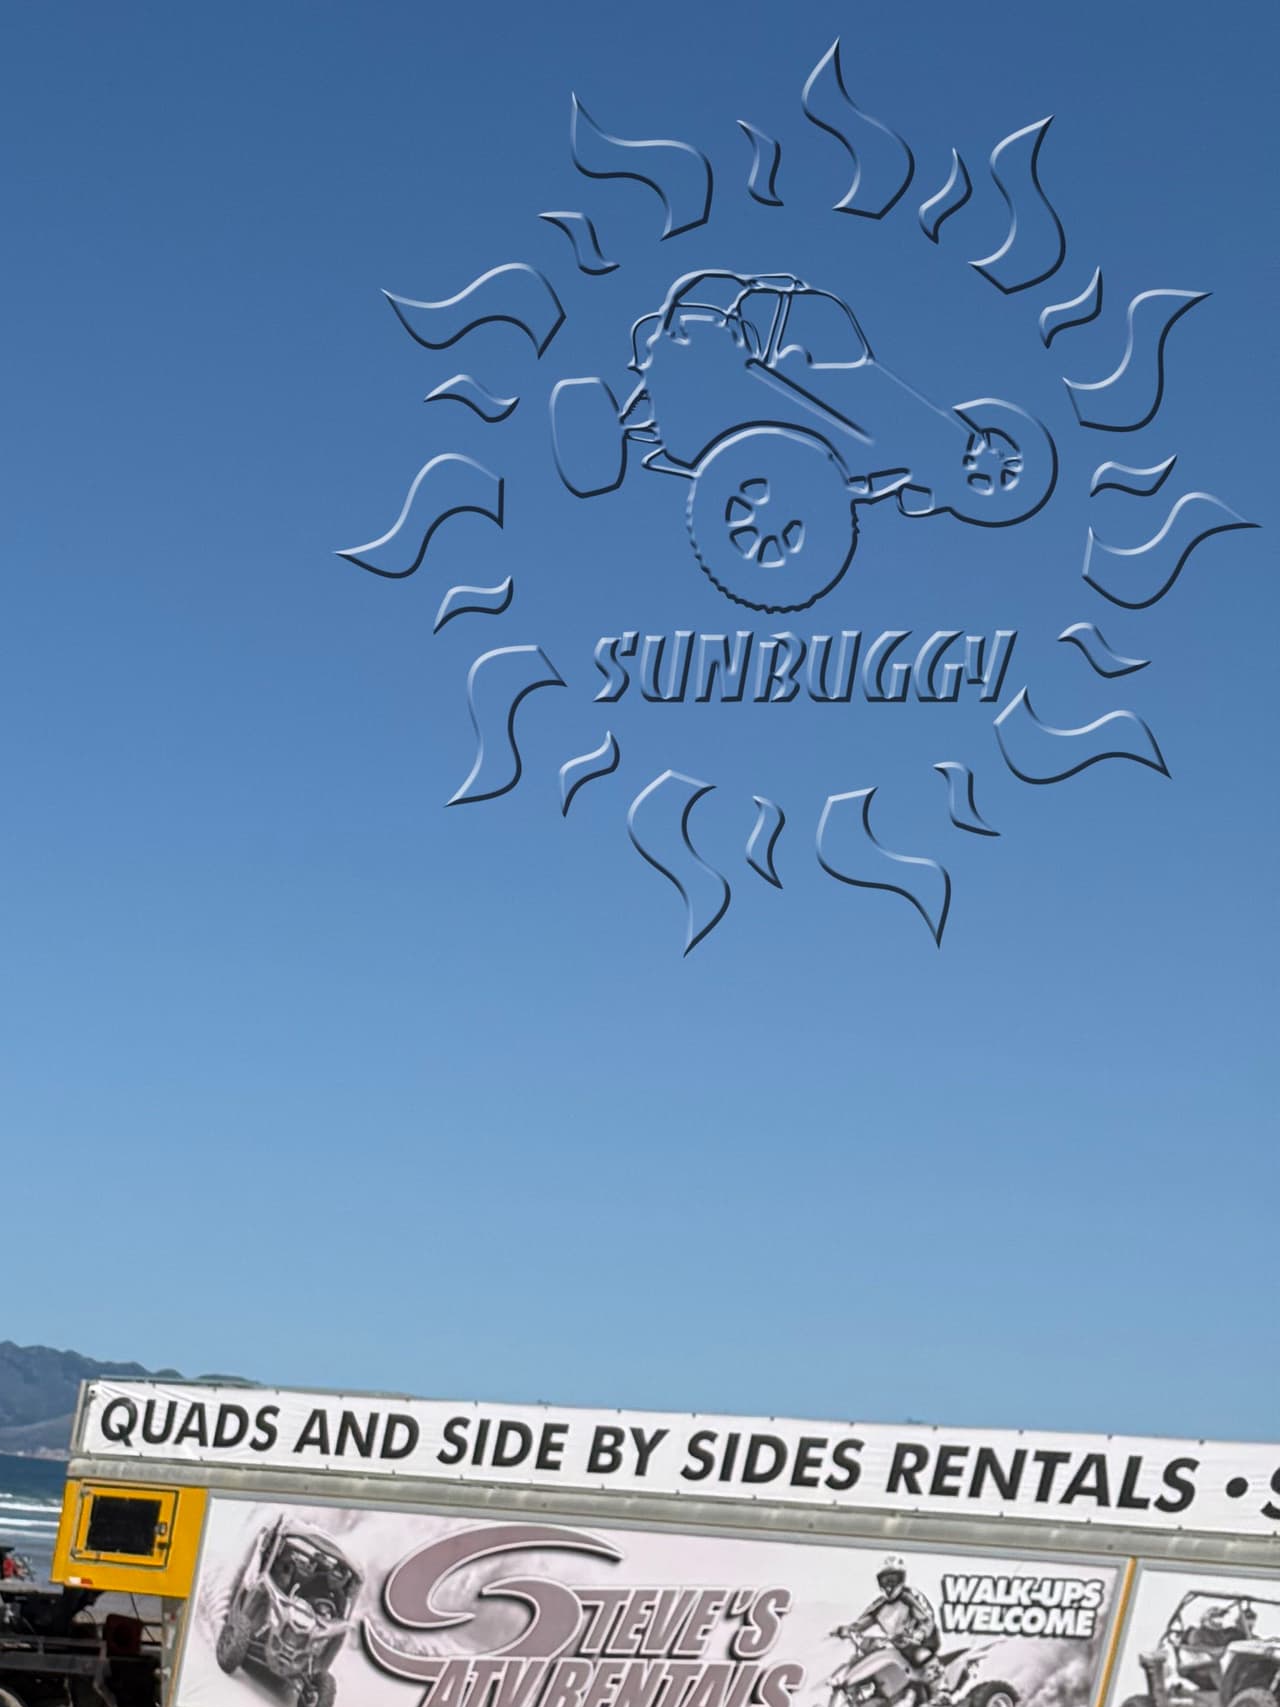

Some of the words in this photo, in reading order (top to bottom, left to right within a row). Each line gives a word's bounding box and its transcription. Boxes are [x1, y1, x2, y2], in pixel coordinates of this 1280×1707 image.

[99, 1396, 279, 1451] QUADS
[293, 1408, 421, 1460] AND
[436, 1416, 569, 1471] SIDE
[586, 1425, 669, 1477] BY
[680, 1429, 864, 1491] SIDES
[886, 1441, 1200, 1513] RENTALS
[362, 1522, 792, 1681] STEVE'S
[941, 1574, 1106, 1609] WALK-UPS
[941, 1603, 1097, 1638] WELCOME
